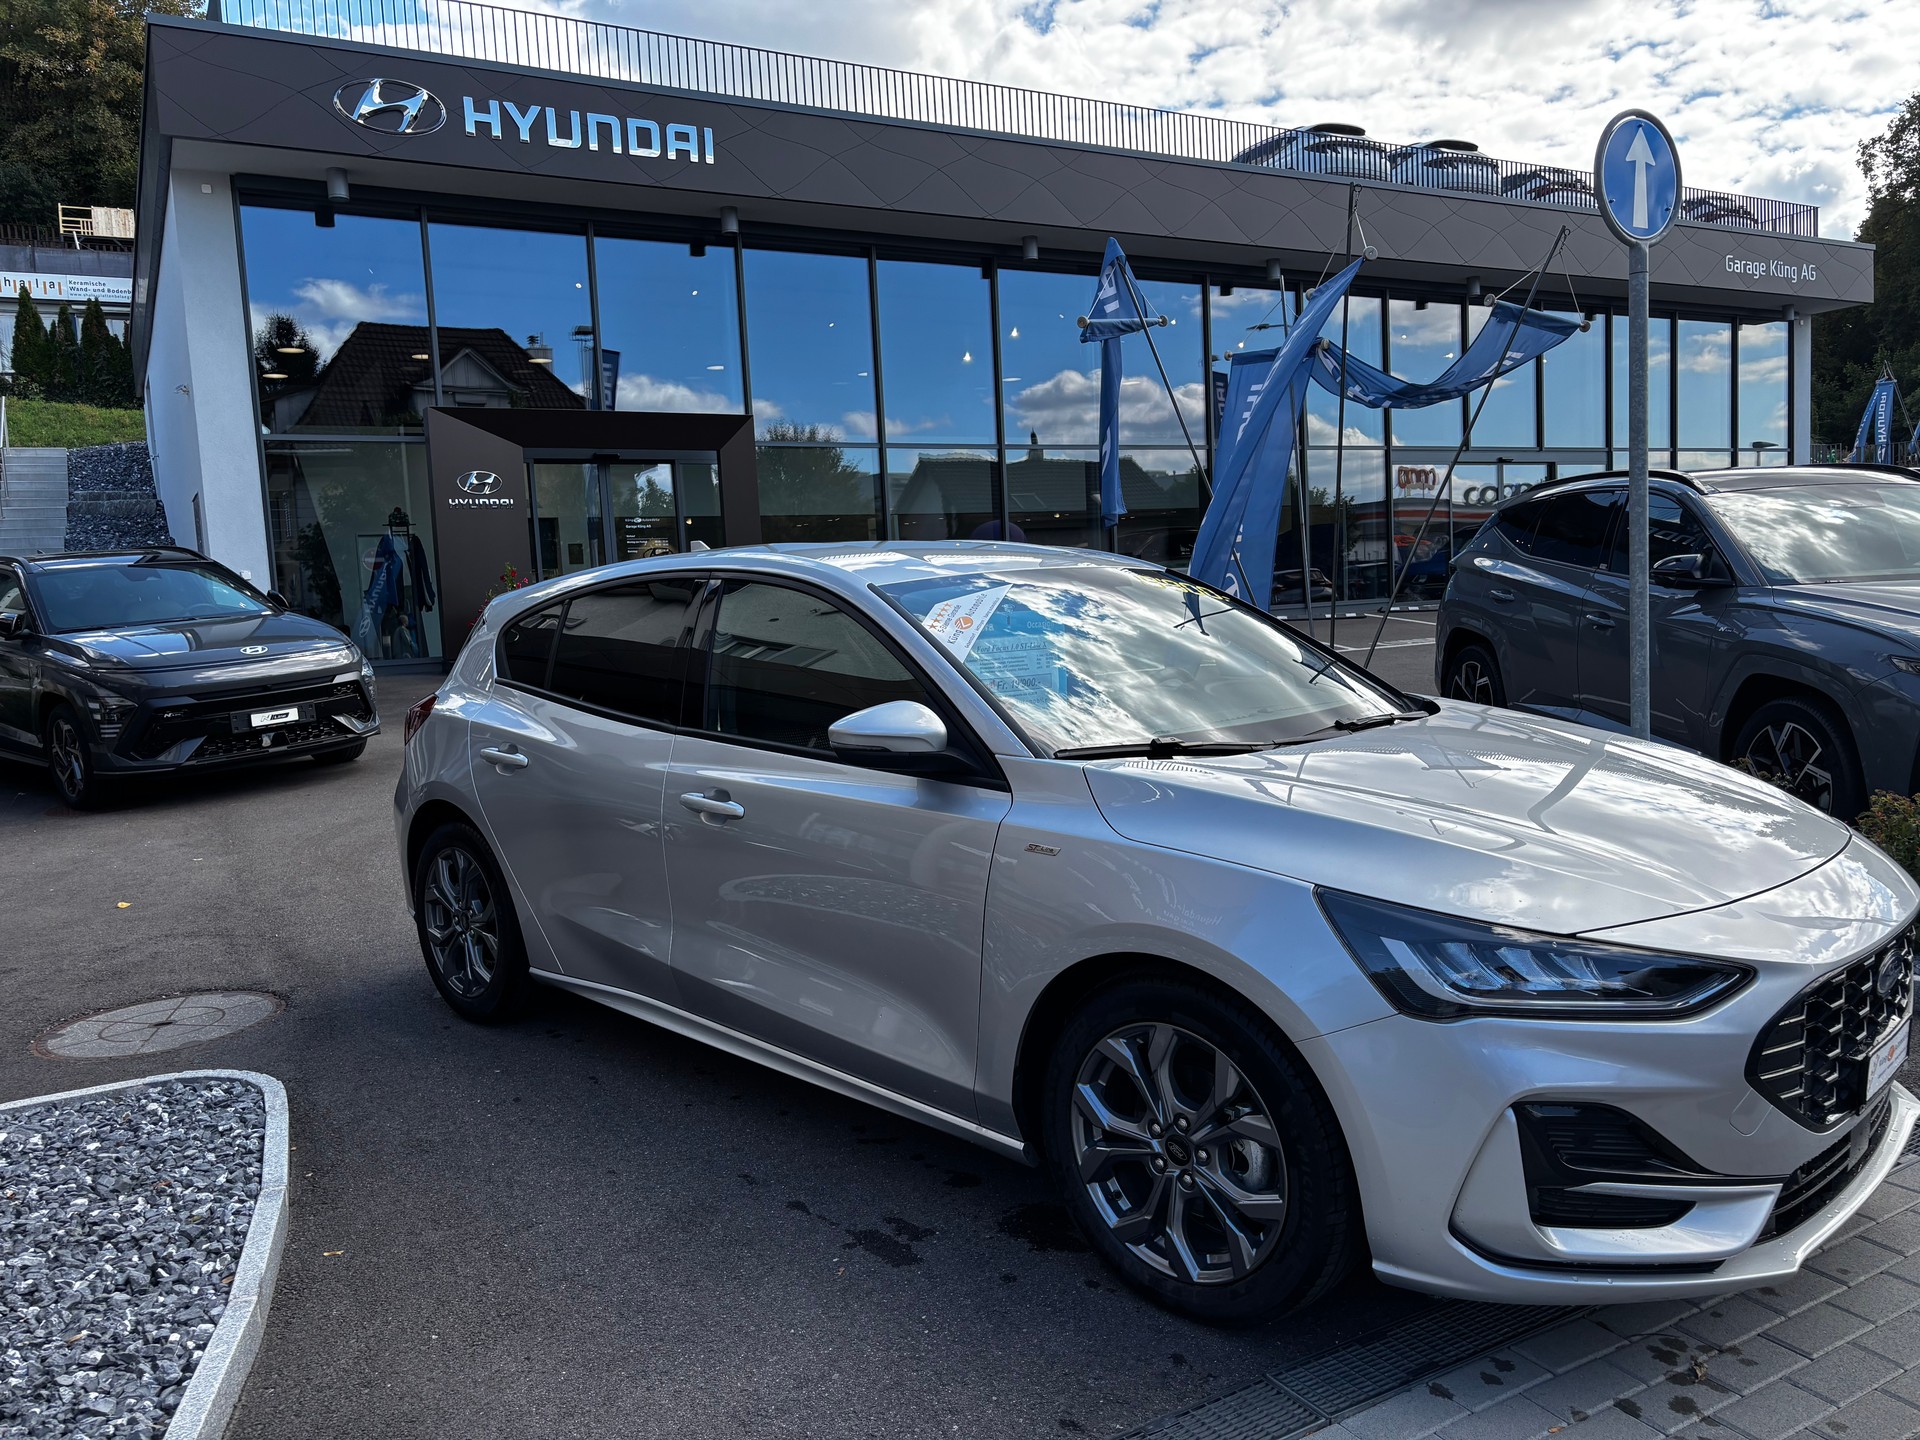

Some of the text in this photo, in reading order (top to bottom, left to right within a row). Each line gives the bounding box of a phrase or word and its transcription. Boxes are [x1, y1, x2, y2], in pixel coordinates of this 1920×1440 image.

[462, 95, 715, 166] HYUNDAI
[1725, 254, 1817, 283] Garage Küng AG
[68, 279, 107, 288] Keramische
[946, 628, 964, 645] Küng
[976, 645, 991, 653] Ford
[991, 644, 1010, 652] Focus
[996, 679, 1008, 691] Fr.
